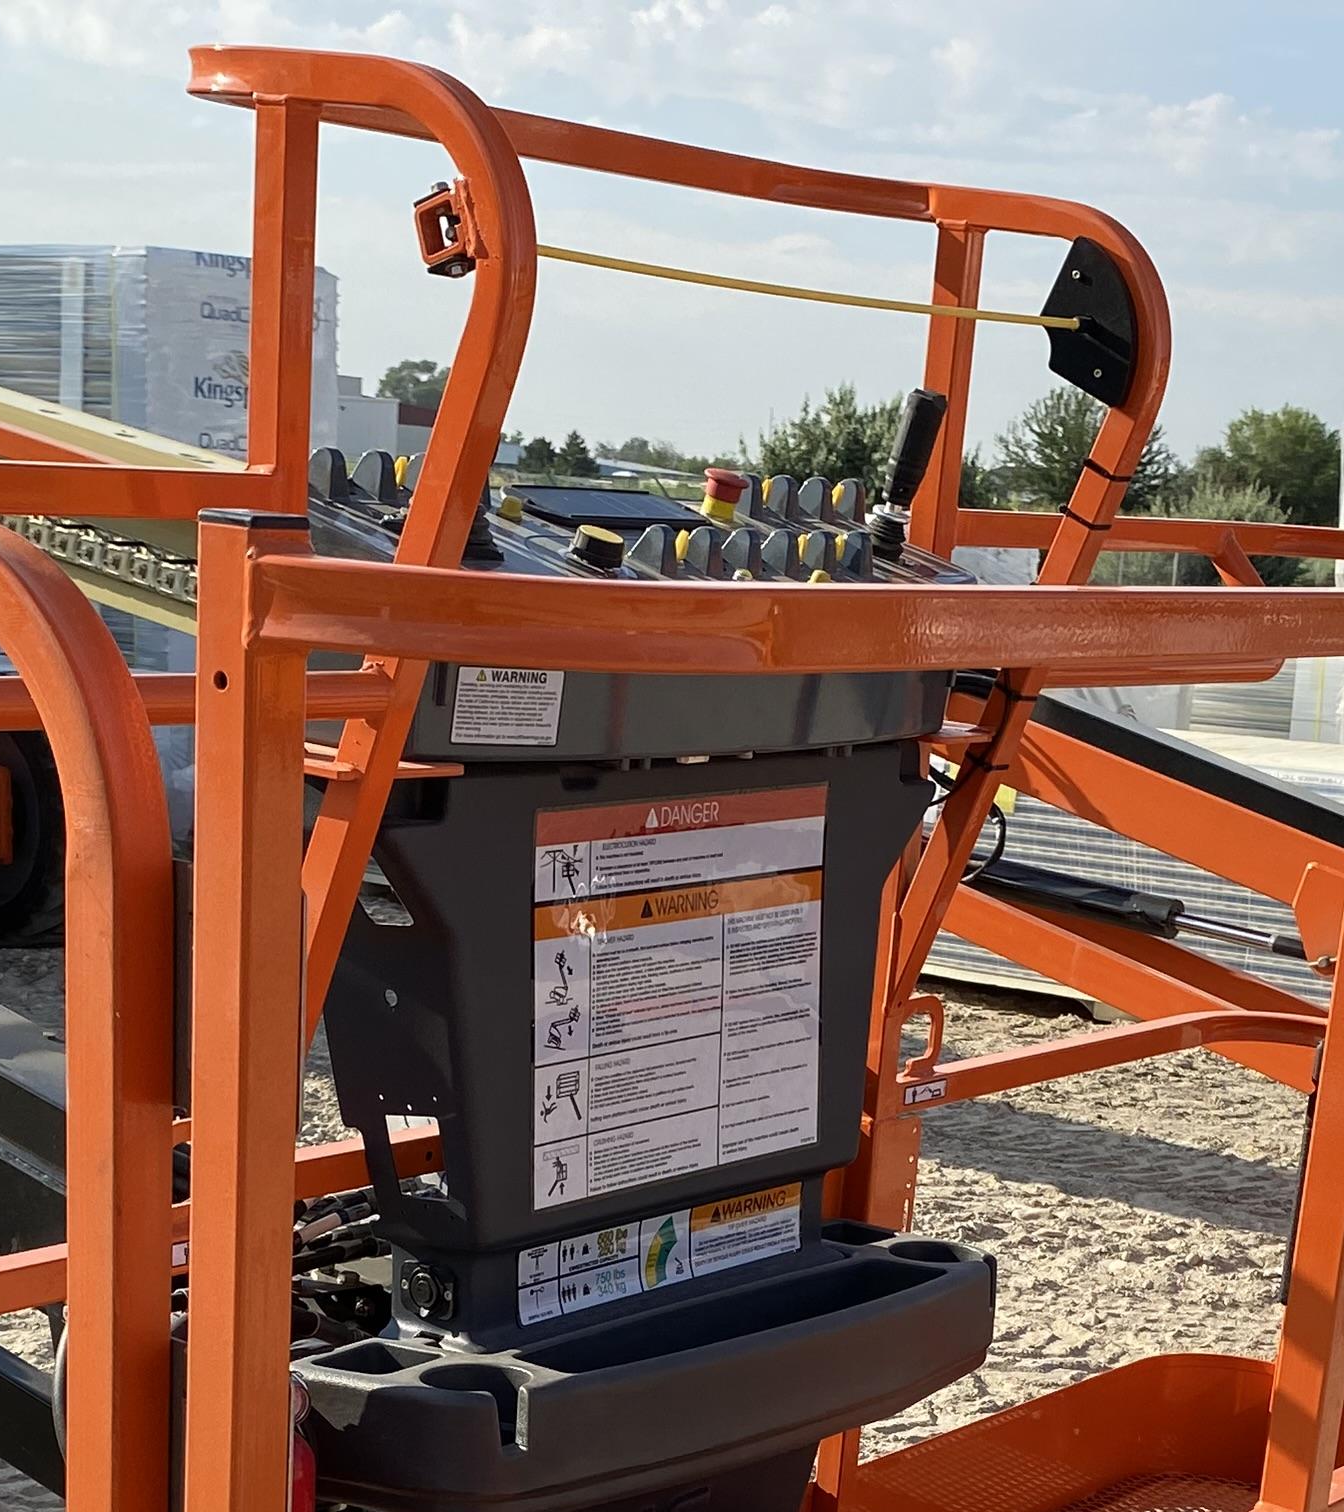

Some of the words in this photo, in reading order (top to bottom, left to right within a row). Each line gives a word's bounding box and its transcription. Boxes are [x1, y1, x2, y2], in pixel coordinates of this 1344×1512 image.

[491, 670, 548, 684] WARNING
[660, 801, 720, 828] DANGER
[656, 889, 720, 916] WARNING
[722, 1190, 786, 1220] WARNING
[595, 1271, 611, 1285] 750
[614, 1268, 626, 1280] lbs
[598, 1283, 613, 1297] 340
[616, 1282, 627, 1295] kg
